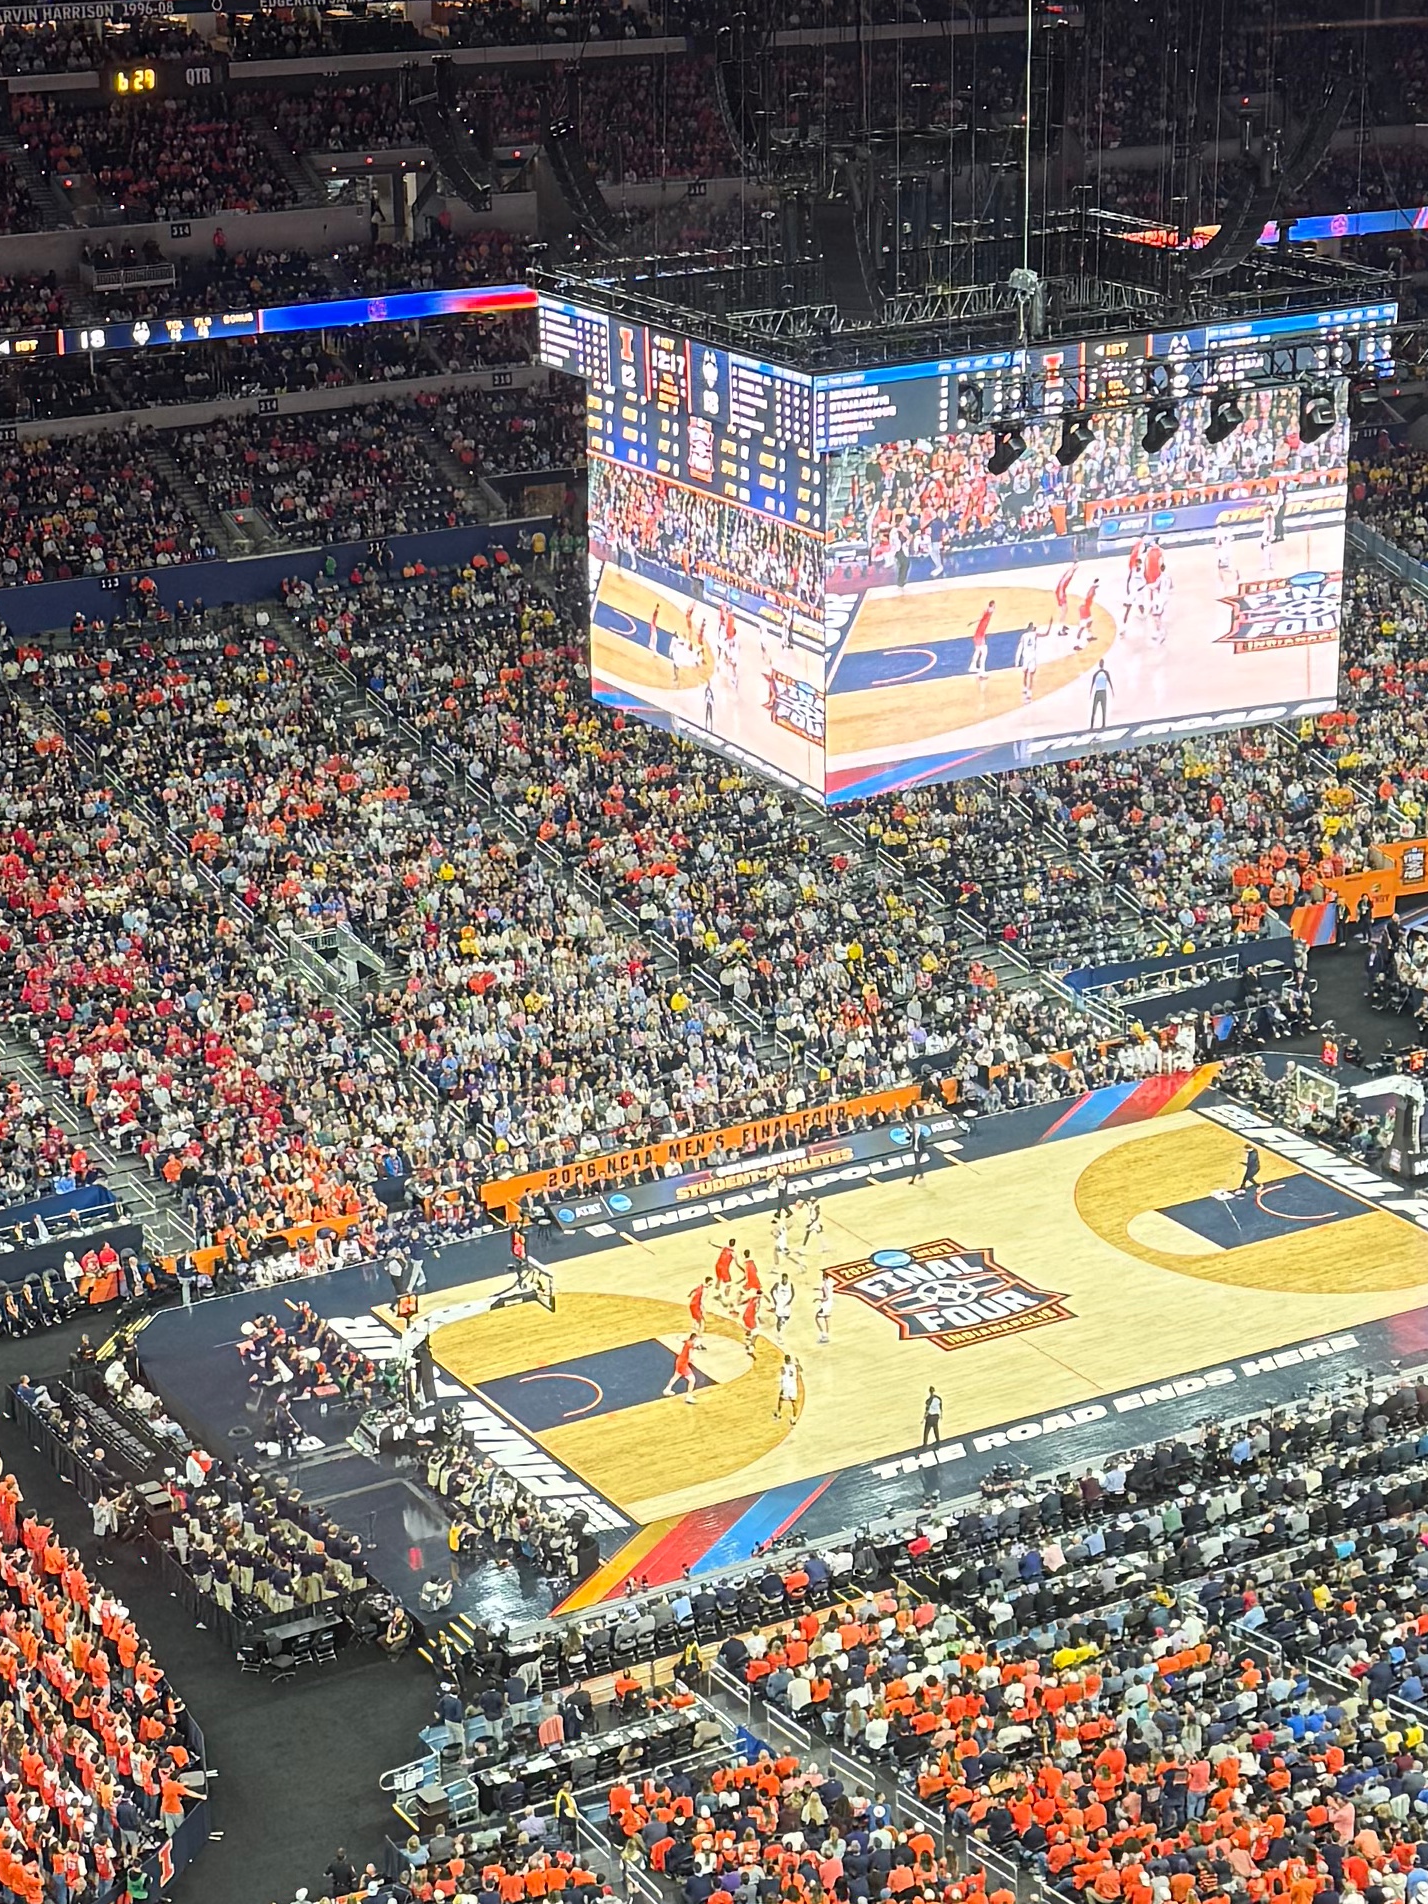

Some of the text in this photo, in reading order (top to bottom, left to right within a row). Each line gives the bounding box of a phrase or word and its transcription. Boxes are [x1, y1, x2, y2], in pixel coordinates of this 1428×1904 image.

[43, 3, 115, 22] HARRISON
[122, 1, 174, 17] 1996-08
[185, 67, 212, 87] QTR
[80, 328, 106, 350] 18
[621, 365, 637, 388] 12
[651, 348, 686, 376] 12:17
[548, 1132, 725, 1187] 2026 NCAA MEN'S
[675, 1147, 855, 1201] STUDENT-ATHLETES
[1238, 1126, 1405, 1198] FINAL
[913, 1243, 956, 1260] MEN'S
[854, 1255, 984, 1298] FINAL
[913, 1290, 1040, 1333] FOUR
[942, 1307, 1059, 1345] INDIANAPOLIS
[872, 1333, 1361, 1482] THE ROAD ENDS HERE
